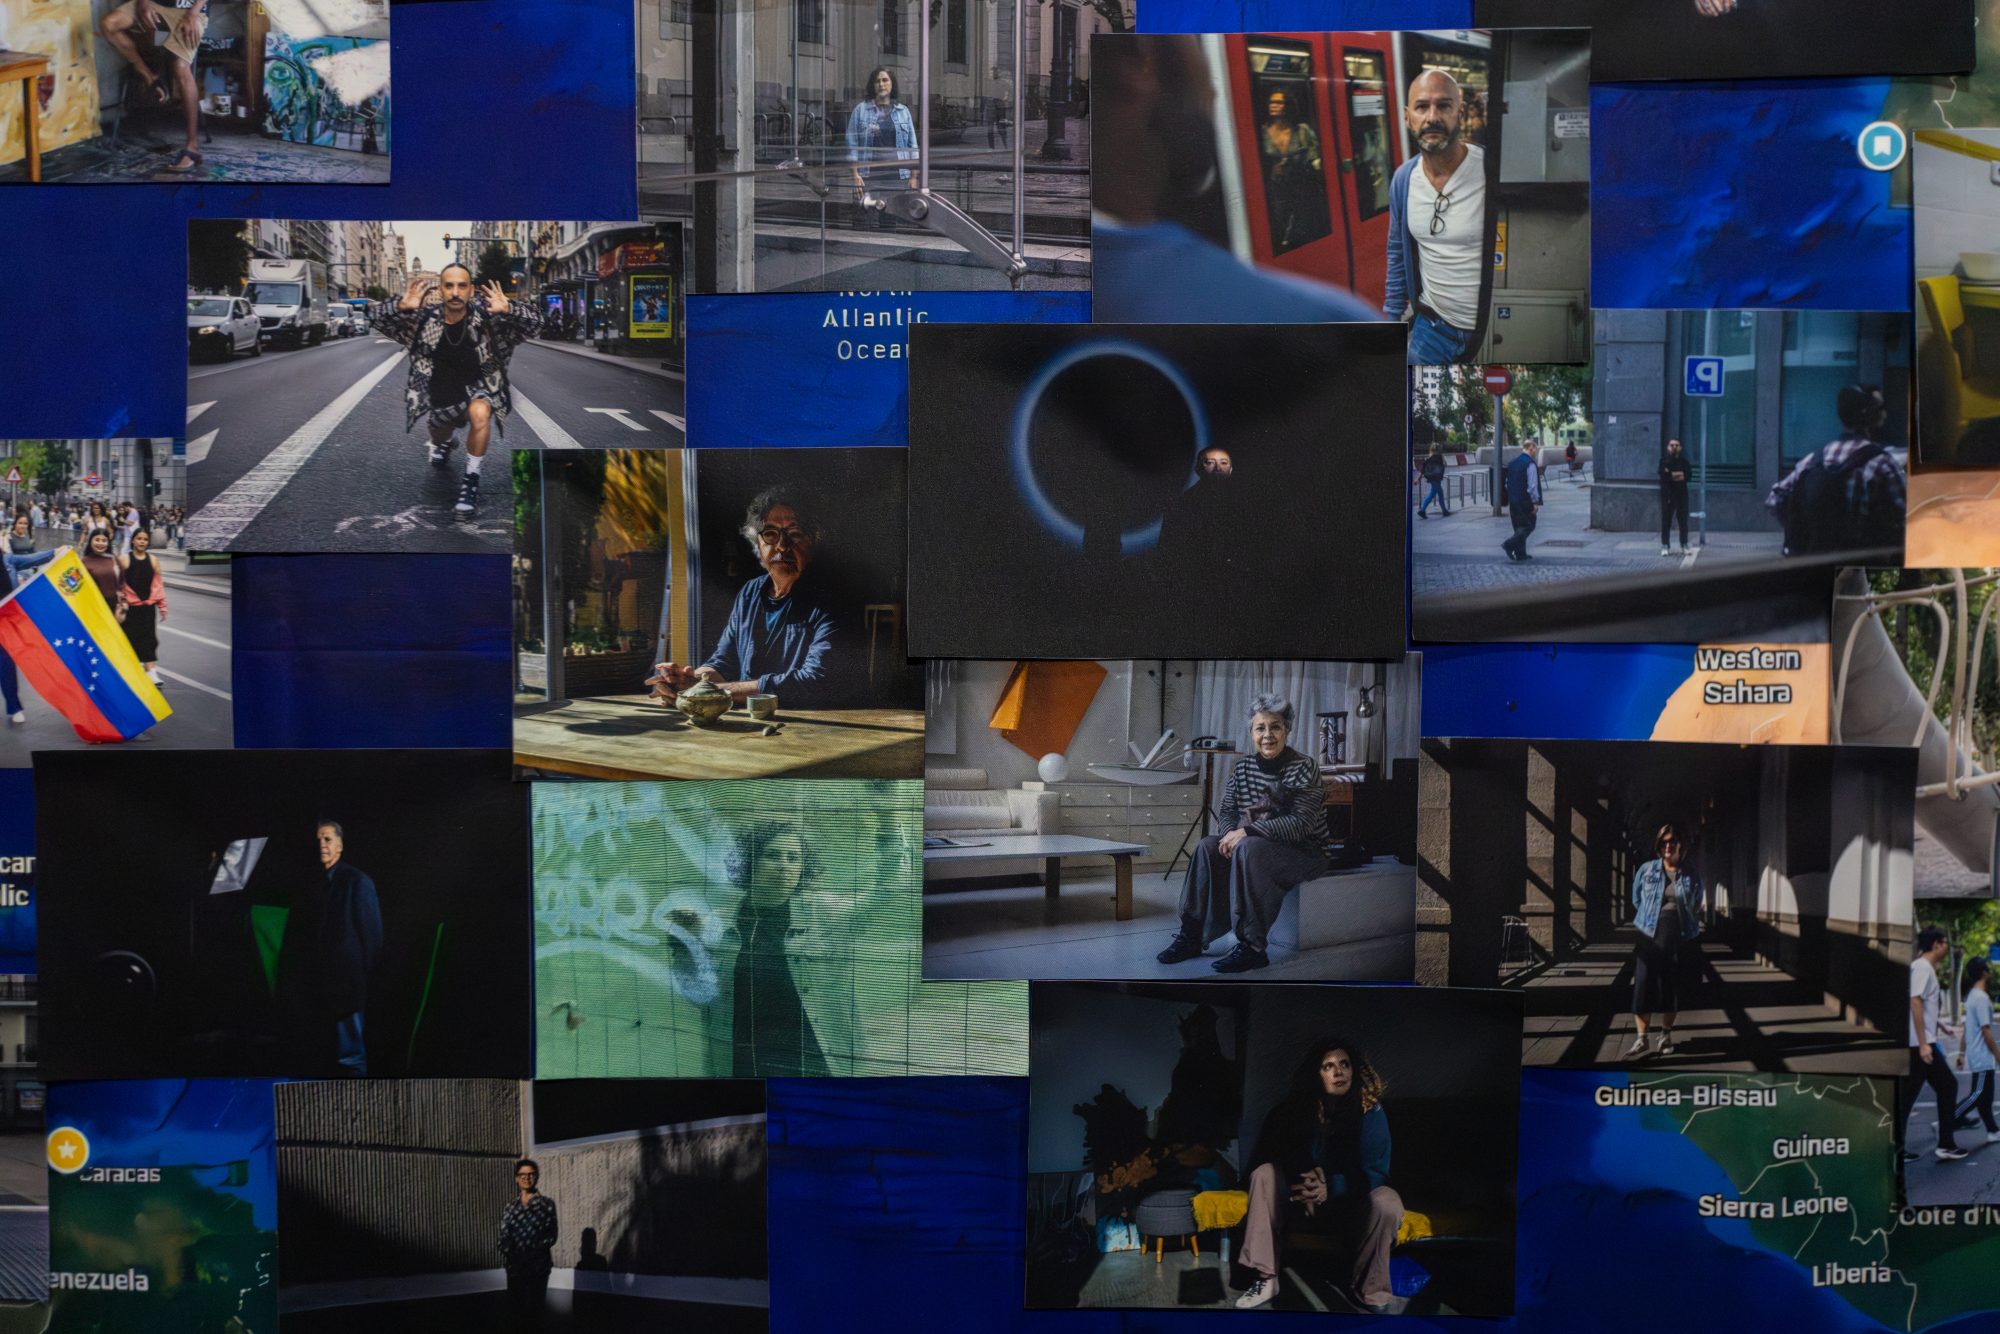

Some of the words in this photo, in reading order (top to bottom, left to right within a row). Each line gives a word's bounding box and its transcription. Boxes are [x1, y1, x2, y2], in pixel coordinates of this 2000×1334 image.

[837, 340, 909, 360] Ocea
[1697, 648, 1800, 670] Western
[1704, 680, 1791, 703] Sahara
[1595, 1084, 1777, 1107] Guinea-Bissau
[1773, 1135, 1850, 1160] Guinea
[1698, 1195, 1775, 1218] Sierra
[1781, 1196, 1849, 1217] Leone
[1812, 1261, 1891, 1287] Liberia
